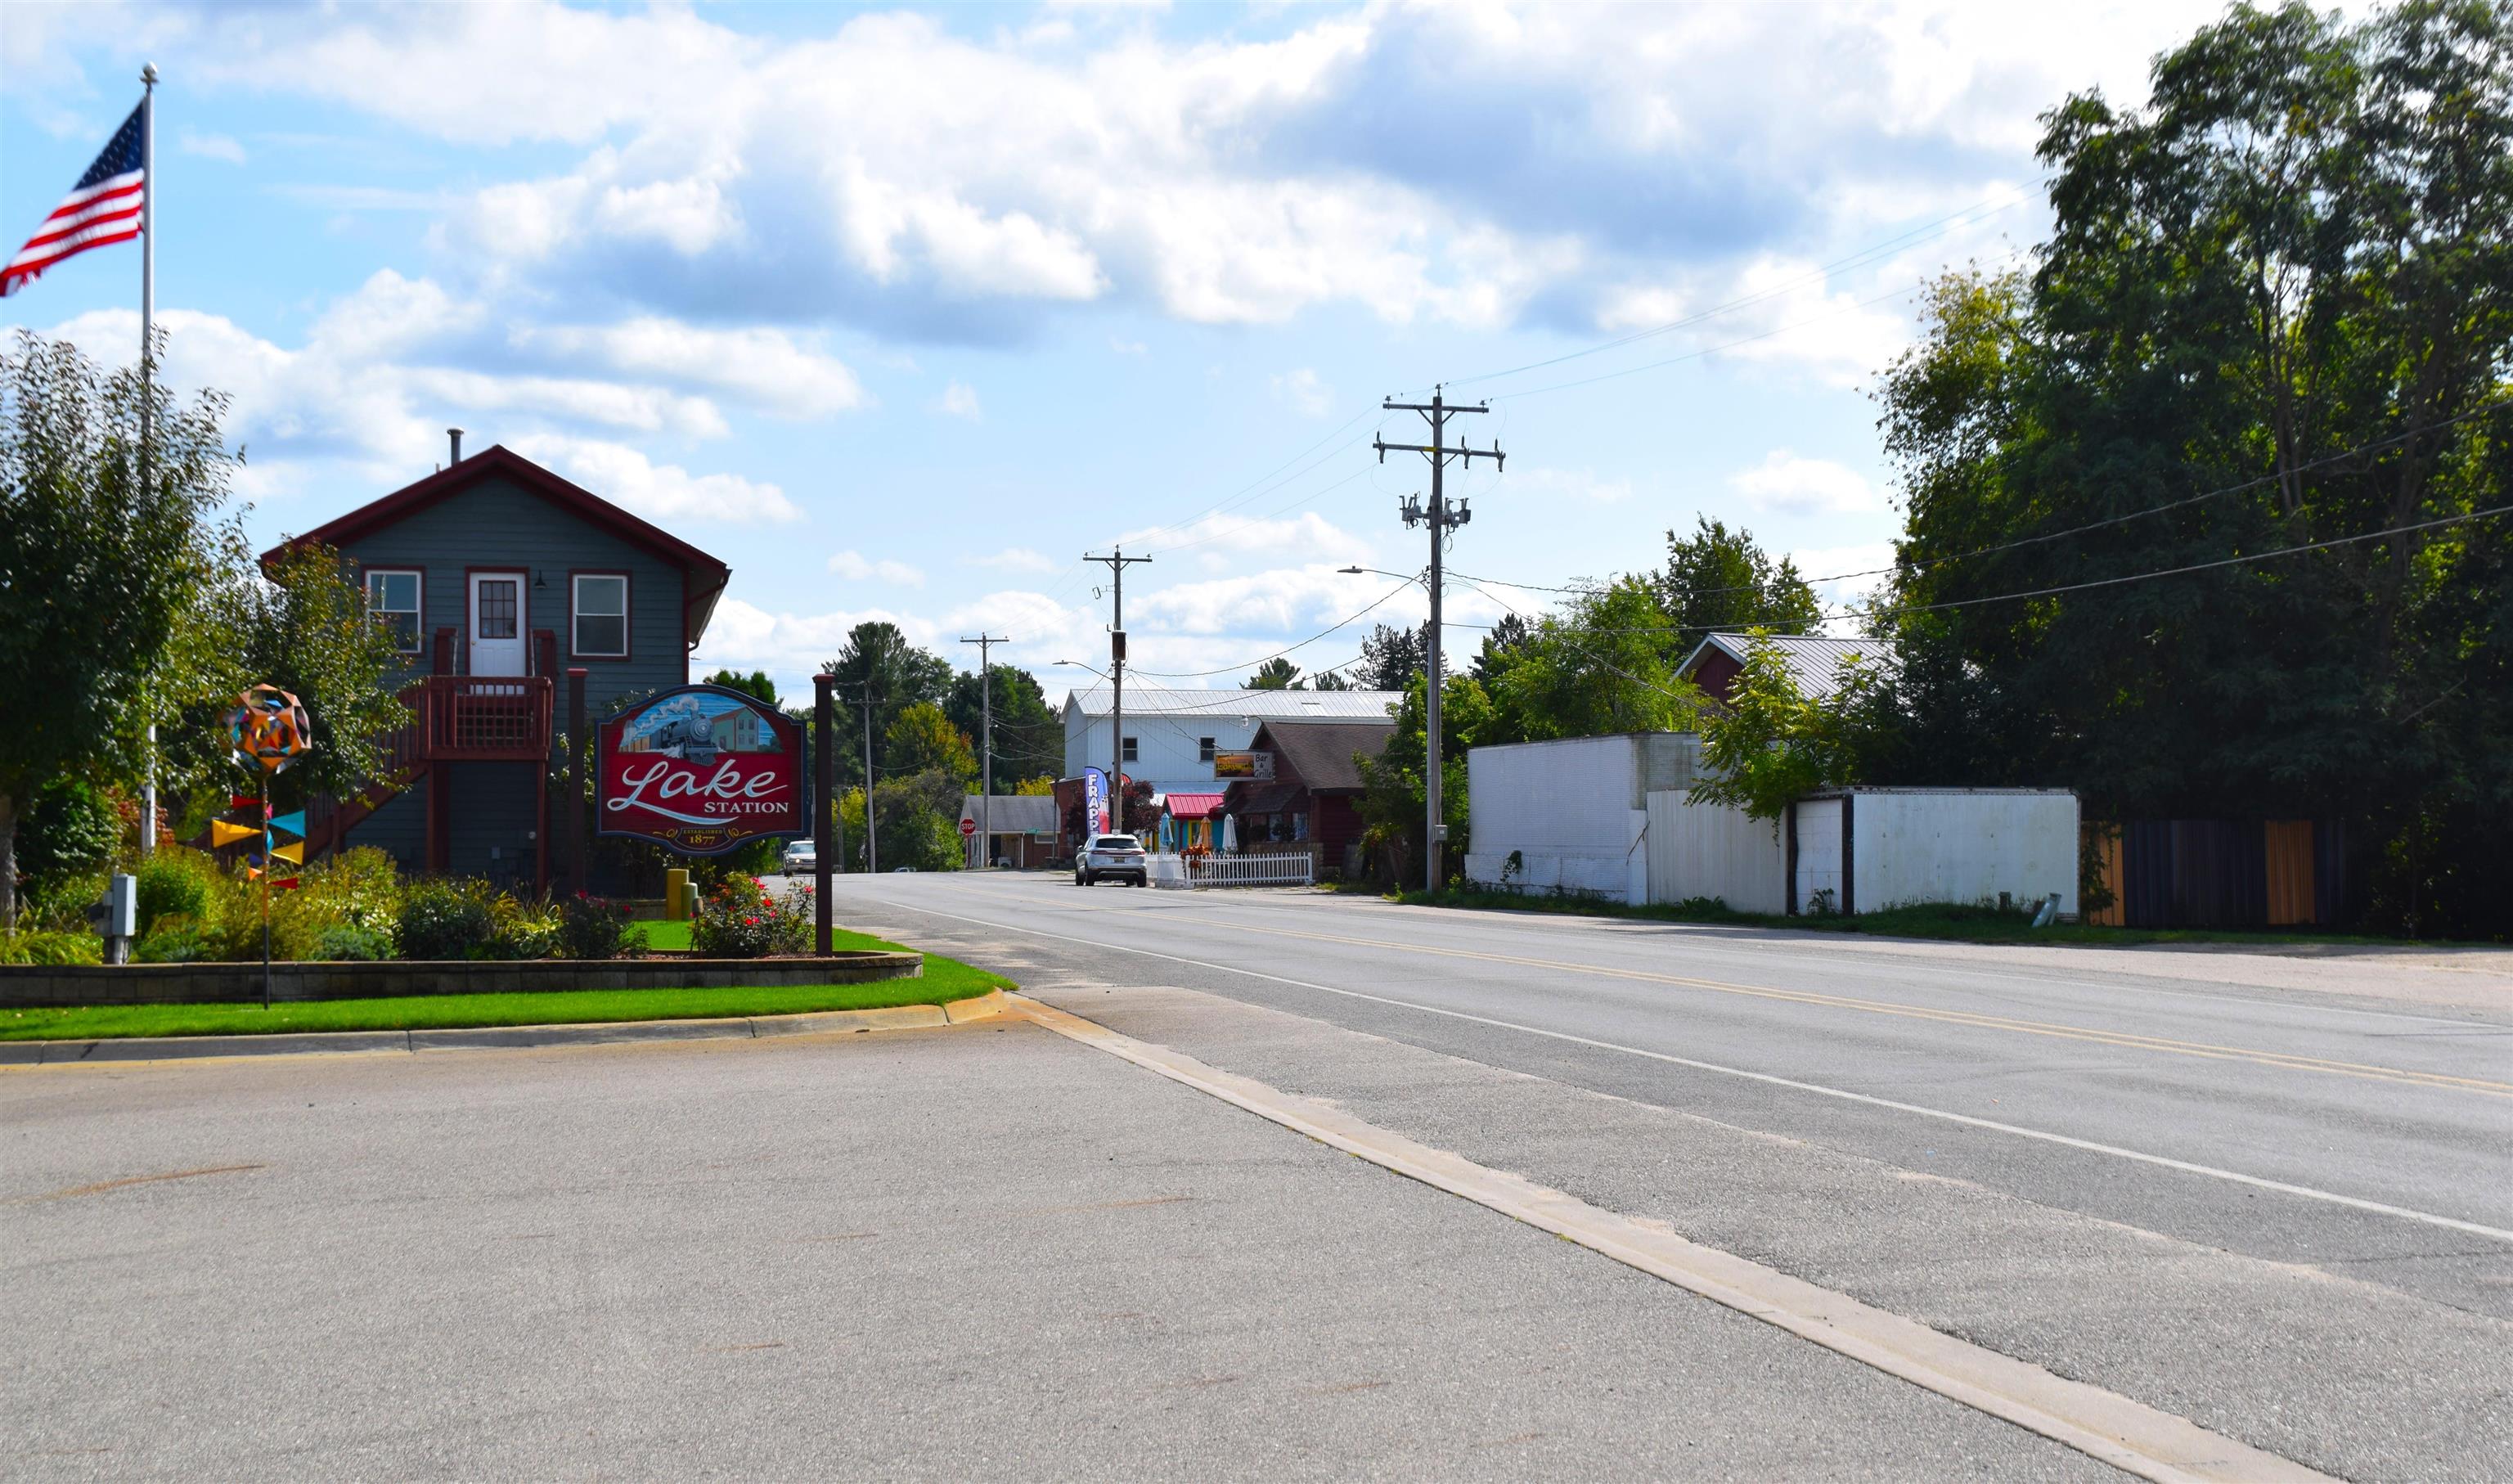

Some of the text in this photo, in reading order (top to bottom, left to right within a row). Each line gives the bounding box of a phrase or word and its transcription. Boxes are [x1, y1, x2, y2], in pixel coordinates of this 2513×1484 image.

[1256, 753, 1268, 762] Bar
[1254, 768, 1271, 779] Grille
[607, 759, 788, 825] Lake
[704, 802, 789, 813] STATION
[690, 834, 715, 845] 1877
